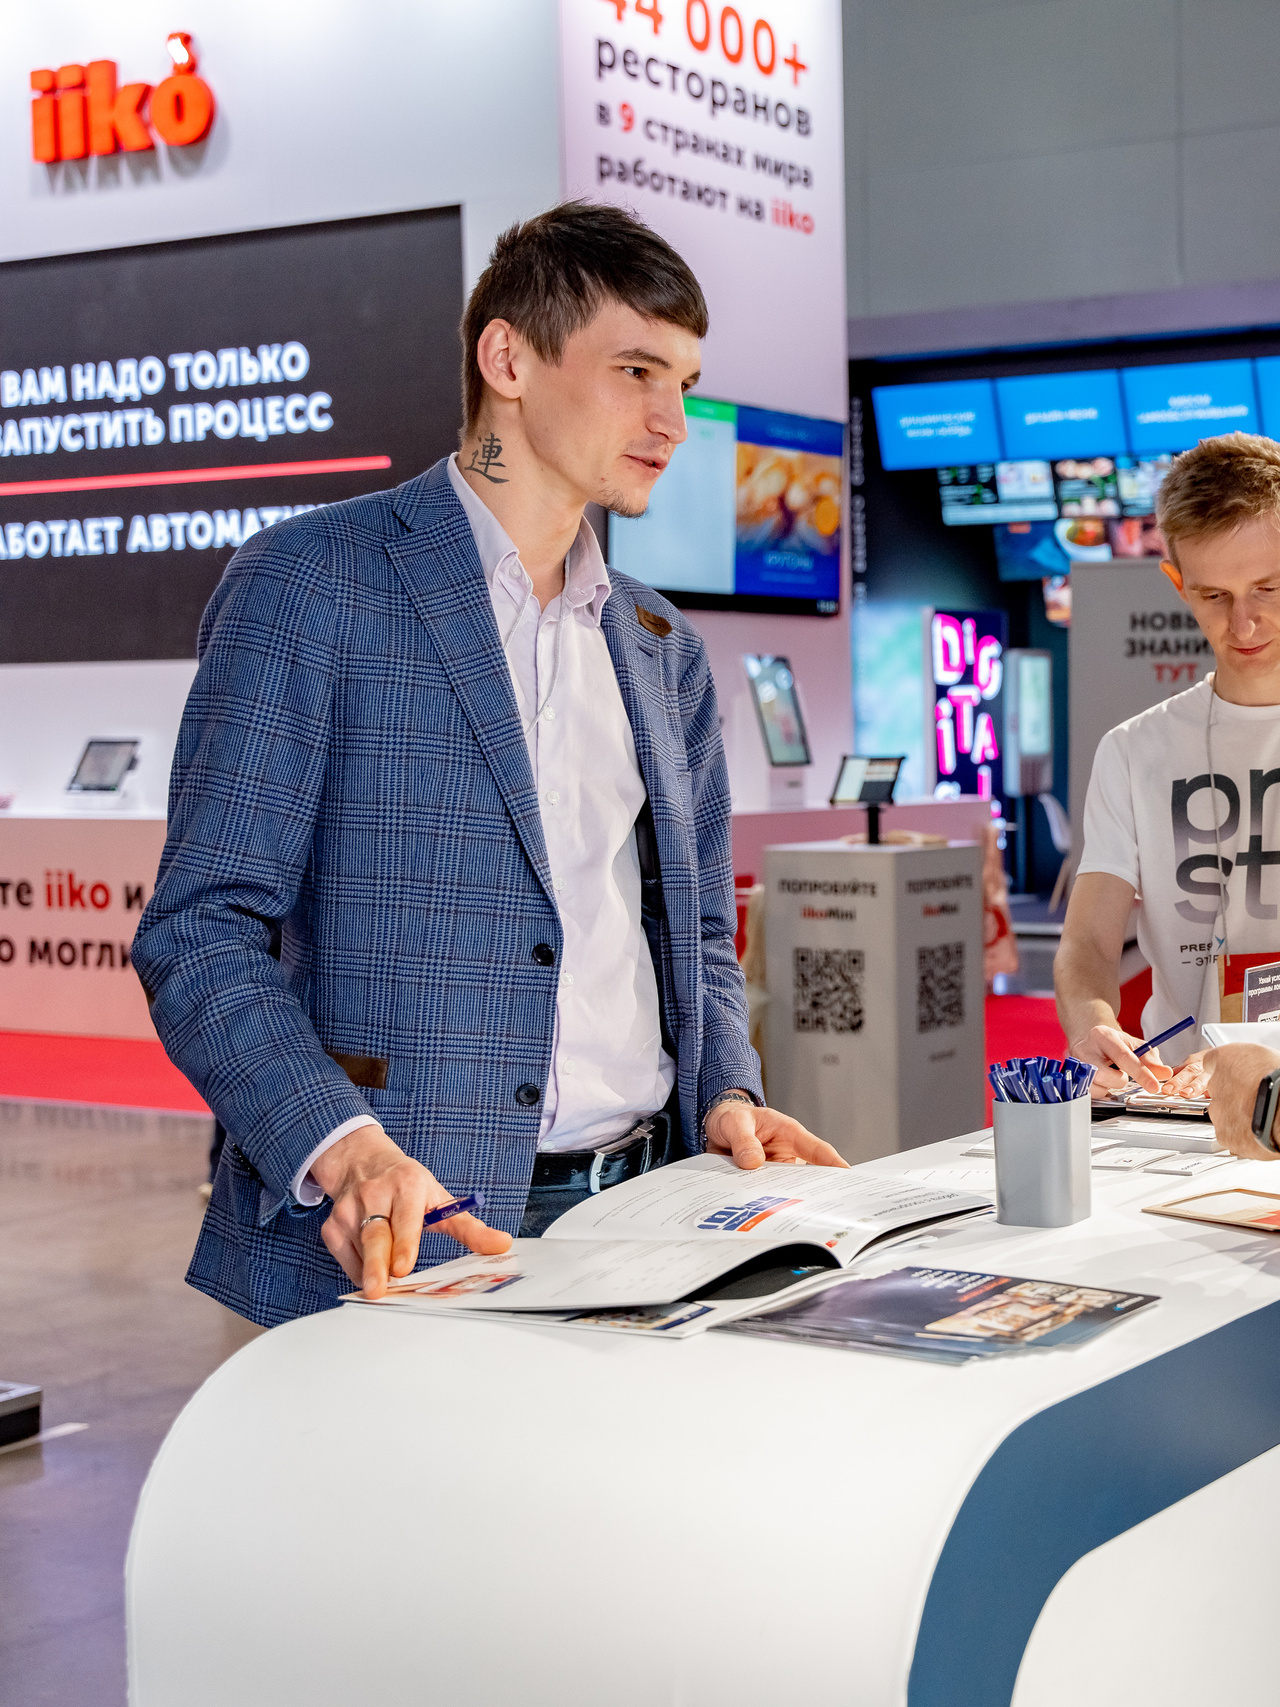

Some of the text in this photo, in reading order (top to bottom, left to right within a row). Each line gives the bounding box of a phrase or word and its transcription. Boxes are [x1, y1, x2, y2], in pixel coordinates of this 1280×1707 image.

[30, 58, 215, 163] iiko
[596, 38, 812, 137] ресторанов
[596, 102, 813, 189] в 9 странах мира
[596, 154, 815, 235] работают на iiko
[1, 341, 310, 408] ВАМ НАДО ТОЛЬКО
[0, 391, 334, 457] АПУСТИТЬ ПРОЦЕСС
[1152, 662, 1198, 683] ТУТ
[46, 870, 111, 910] iiko
